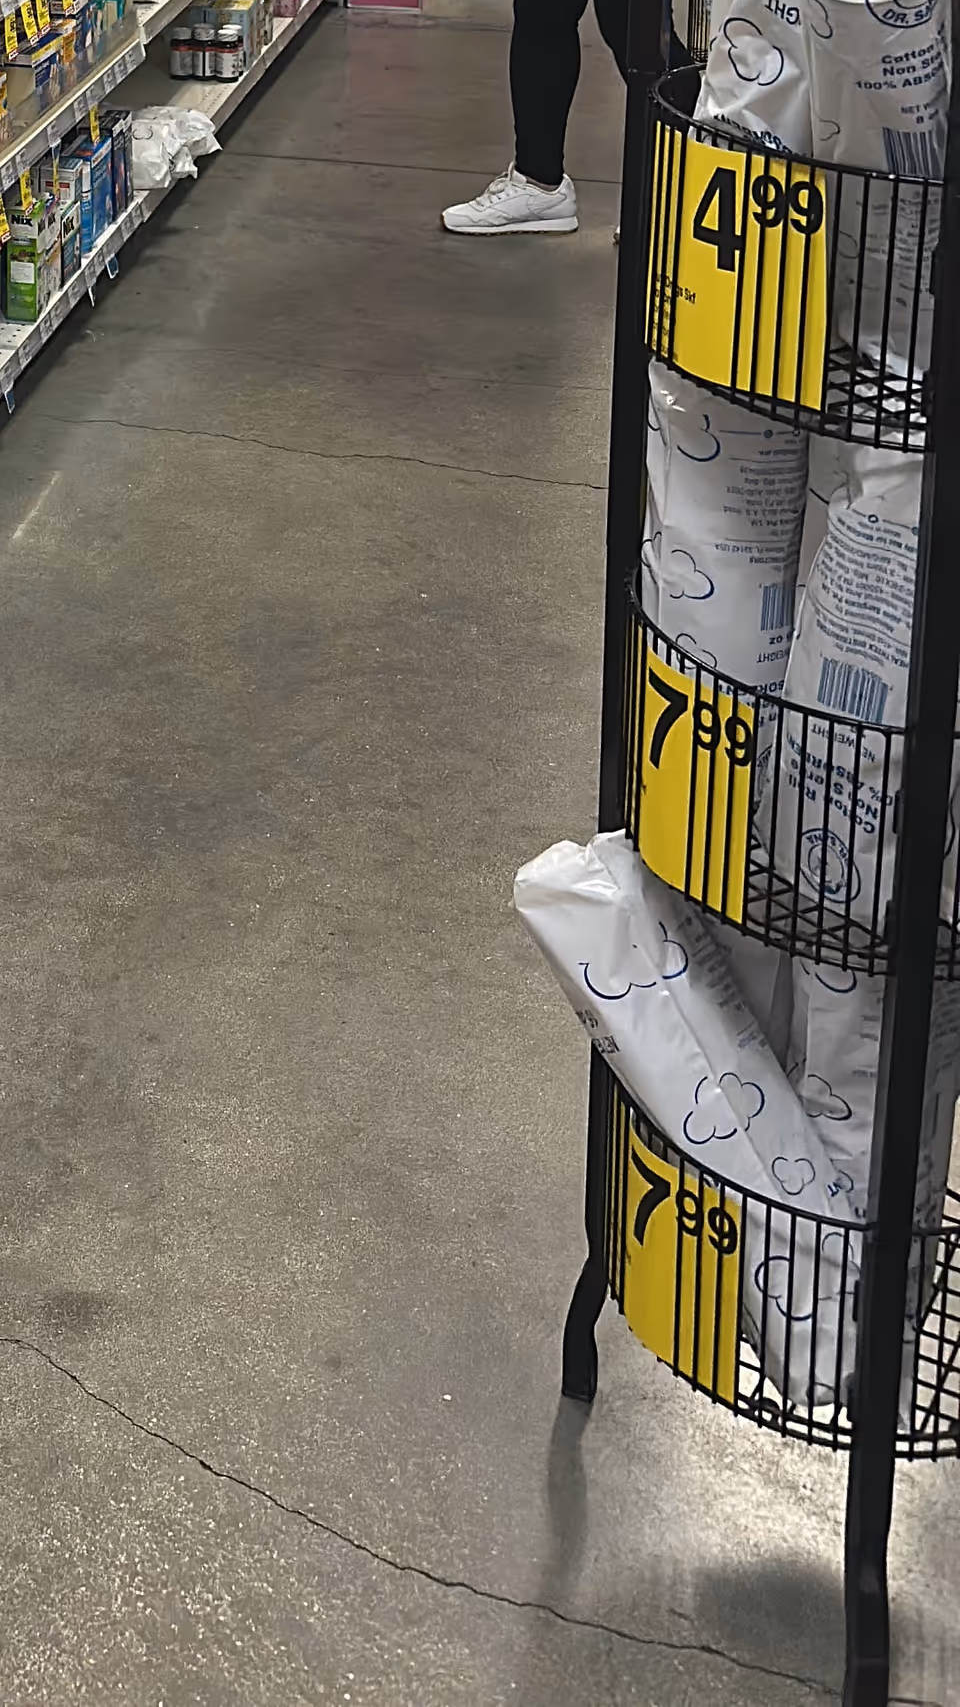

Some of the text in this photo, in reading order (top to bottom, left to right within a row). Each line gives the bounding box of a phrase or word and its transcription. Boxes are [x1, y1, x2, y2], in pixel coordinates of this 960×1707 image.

[881, 44, 935, 64] Cotton
[882, 64, 917, 77] Non
[855, 80, 897, 91] 100%
[11, 213, 33, 227] Nix
